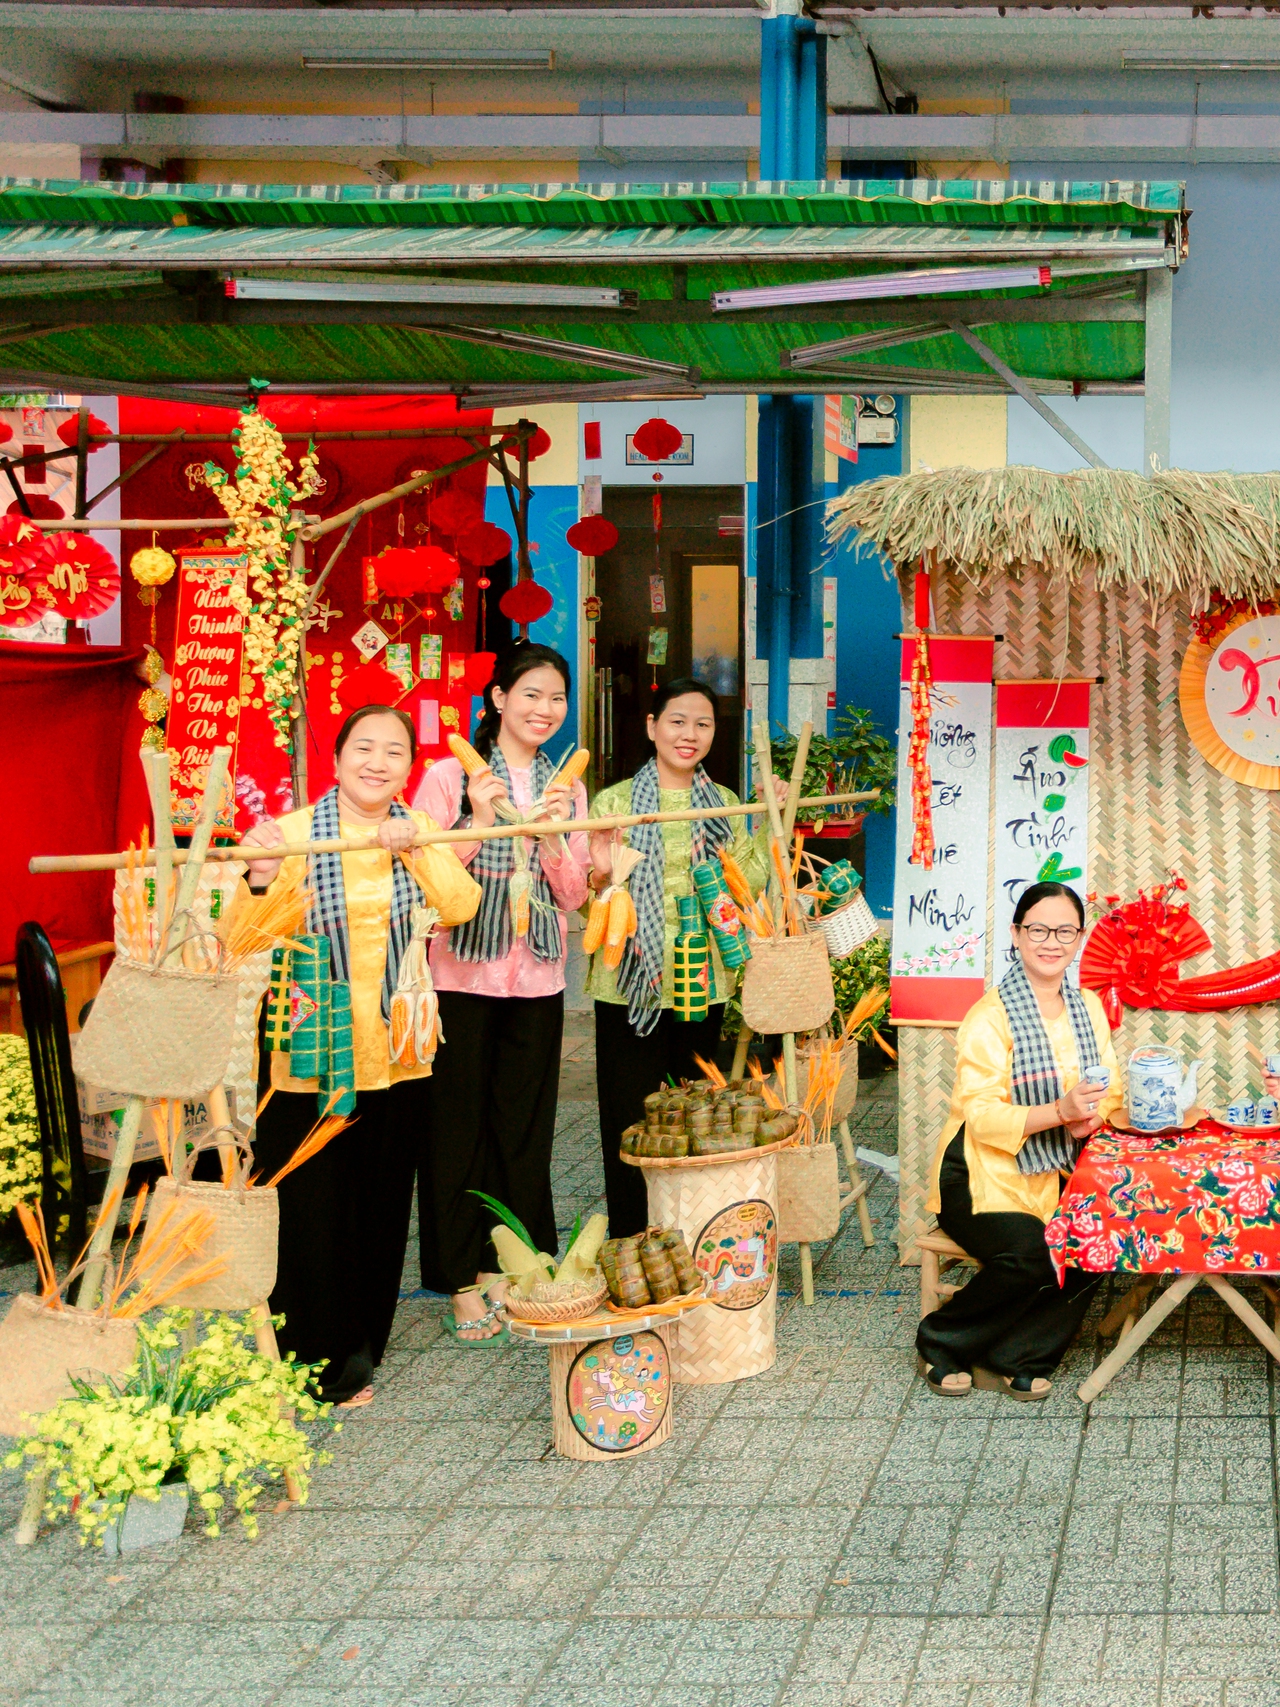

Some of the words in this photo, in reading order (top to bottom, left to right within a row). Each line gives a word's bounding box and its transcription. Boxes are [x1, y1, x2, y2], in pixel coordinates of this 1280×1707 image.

[186, 667, 228, 690] Phúc
[187, 693, 224, 716] Thọ
[187, 719, 218, 739] Vô
[182, 745, 215, 766] Biê
[1005, 811, 1078, 850] Tình
[909, 888, 976, 932] Mình
